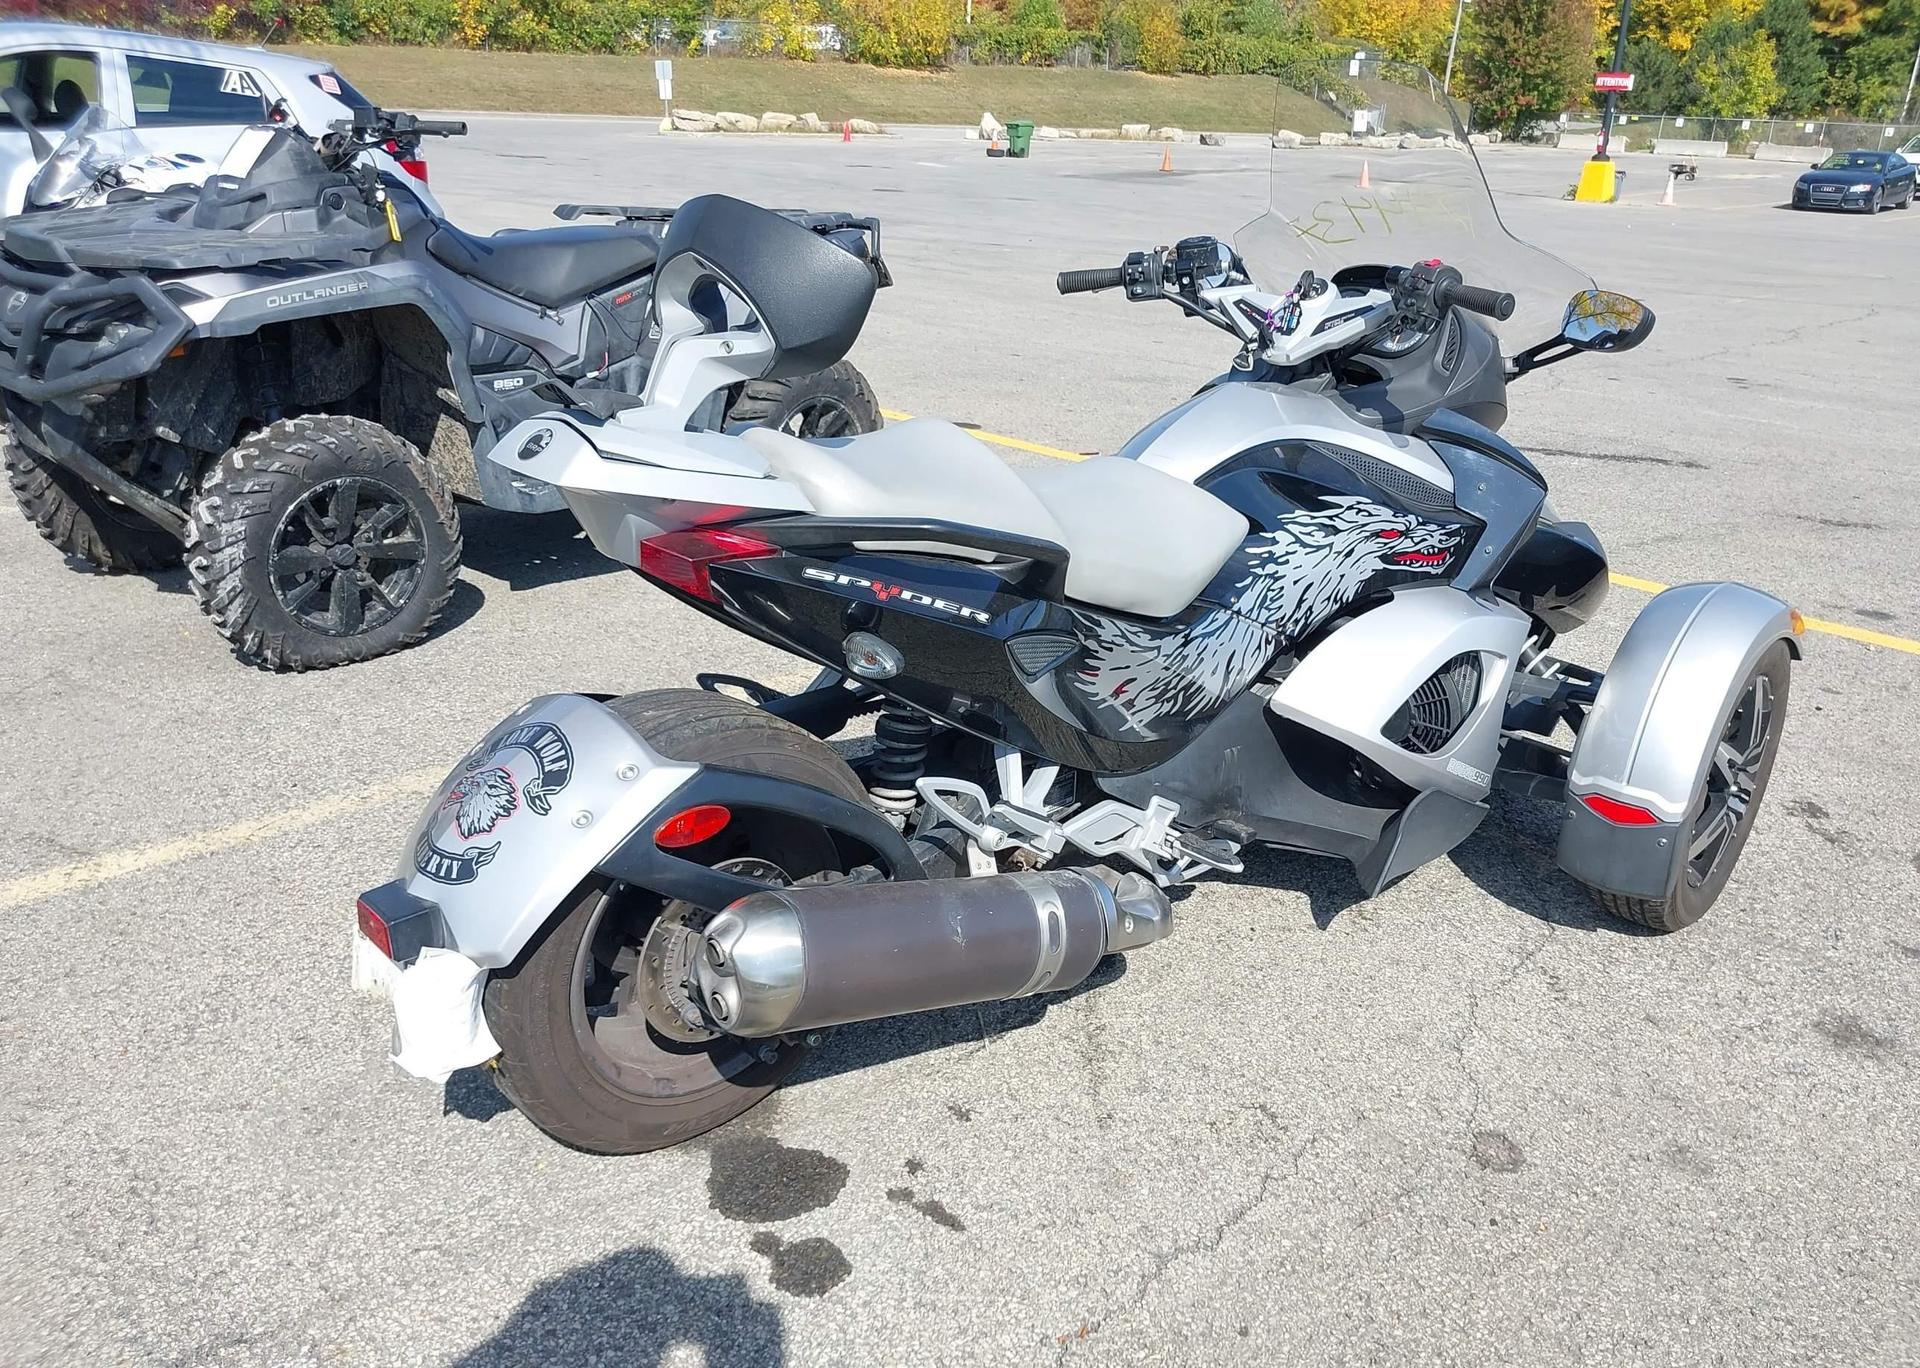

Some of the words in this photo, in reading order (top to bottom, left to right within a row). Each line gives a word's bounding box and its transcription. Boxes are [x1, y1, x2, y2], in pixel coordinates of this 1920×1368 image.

[1596, 76, 1630, 87] ATTENTION
[266, 281, 369, 308] OUTLANDER
[493, 377, 524, 389] 850
[526, 442, 543, 453] BRP
[802, 567, 992, 625] SPYDER
[498, 726, 541, 748] LONE
[533, 730, 568, 772] WOLF
